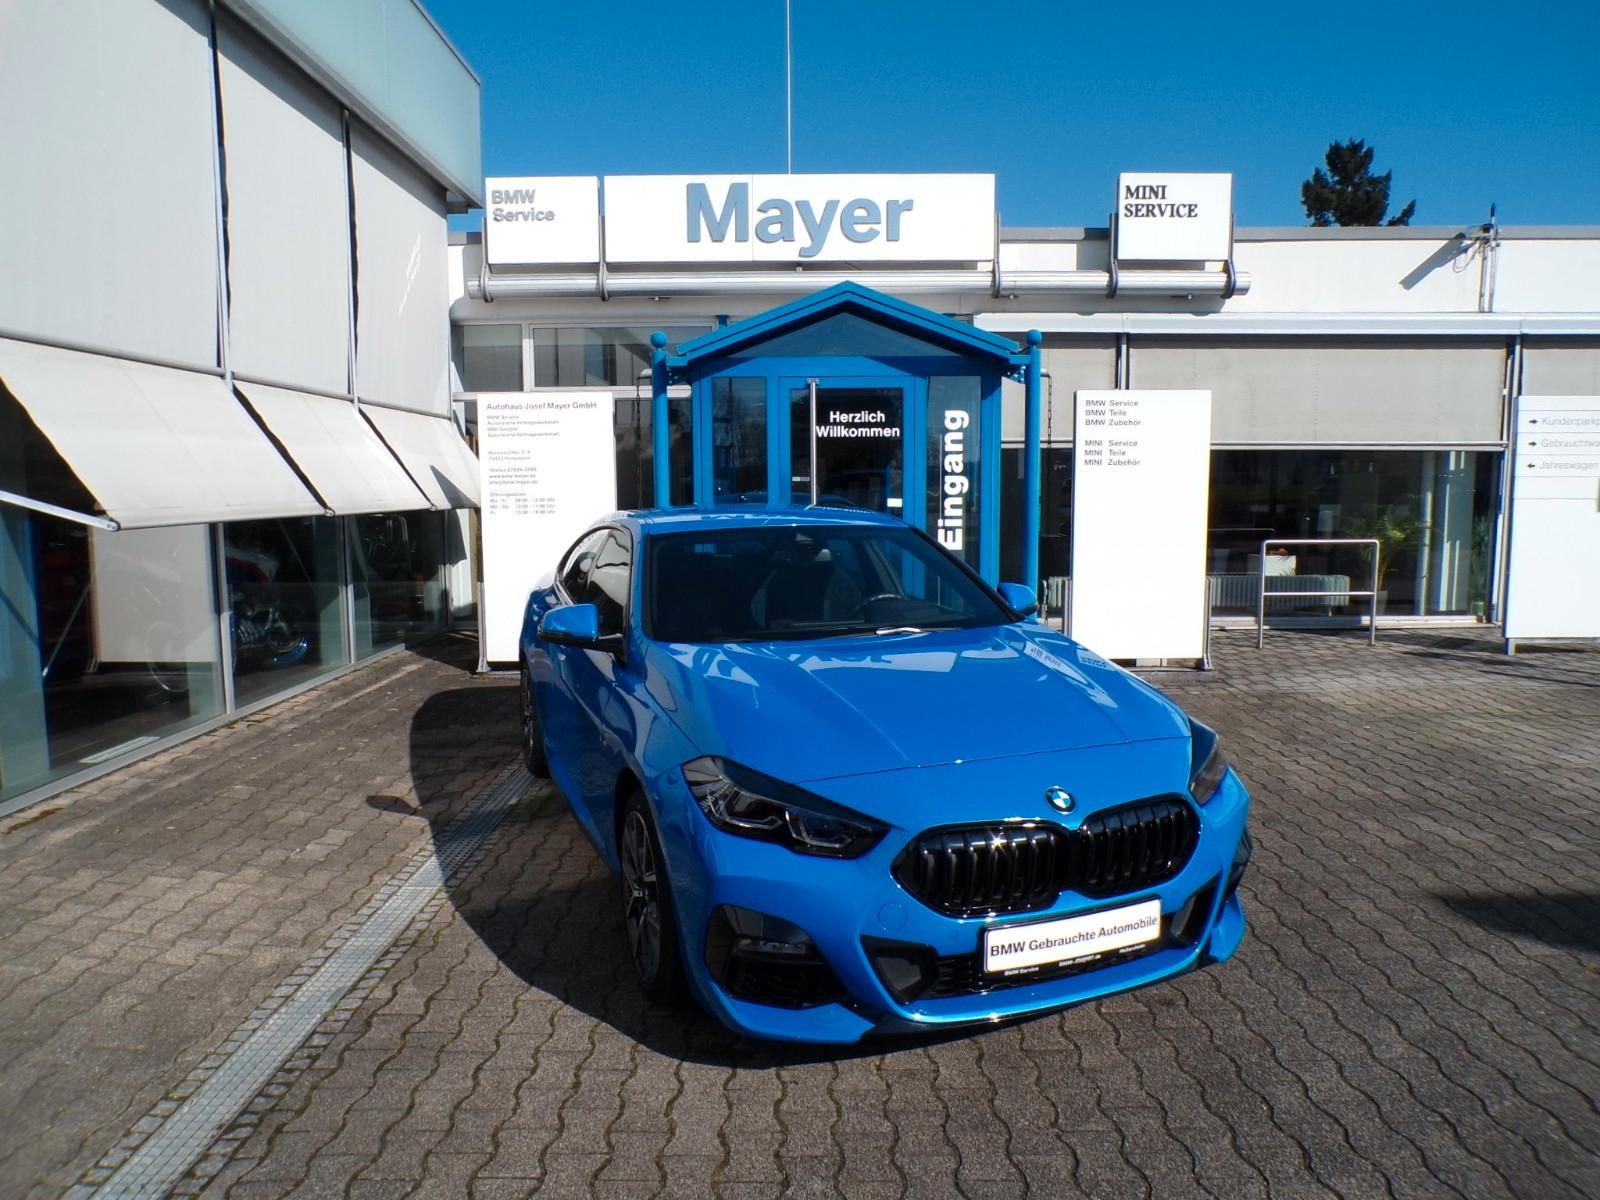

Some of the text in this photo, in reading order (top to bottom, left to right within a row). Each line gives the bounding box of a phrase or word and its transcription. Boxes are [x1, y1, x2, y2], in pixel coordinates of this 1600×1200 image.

[491, 189, 536, 205] BMW
[1124, 185, 1167, 200] MINI
[492, 206, 555, 222] Service
[1124, 203, 1198, 218] SERVICE
[686, 181, 914, 258] Mayer
[524, 402, 545, 410] Josef
[547, 402, 570, 411] Mayer
[572, 401, 597, 409] GmbH
[829, 411, 885, 423] Herzlich
[1108, 418, 1141, 426] Zubehör
[816, 425, 900, 438] Willkommen
[1108, 439, 1138, 447] Service
[1108, 458, 1141, 466] Zubehör
[1539, 460, 1599, 471] Jahreswagen
[937, 409, 970, 551] Eingang
[990, 941, 1025, 957] BMW
[1029, 931, 1097, 951] Gebrauchte
[1098, 916, 1158, 938] Automobile
